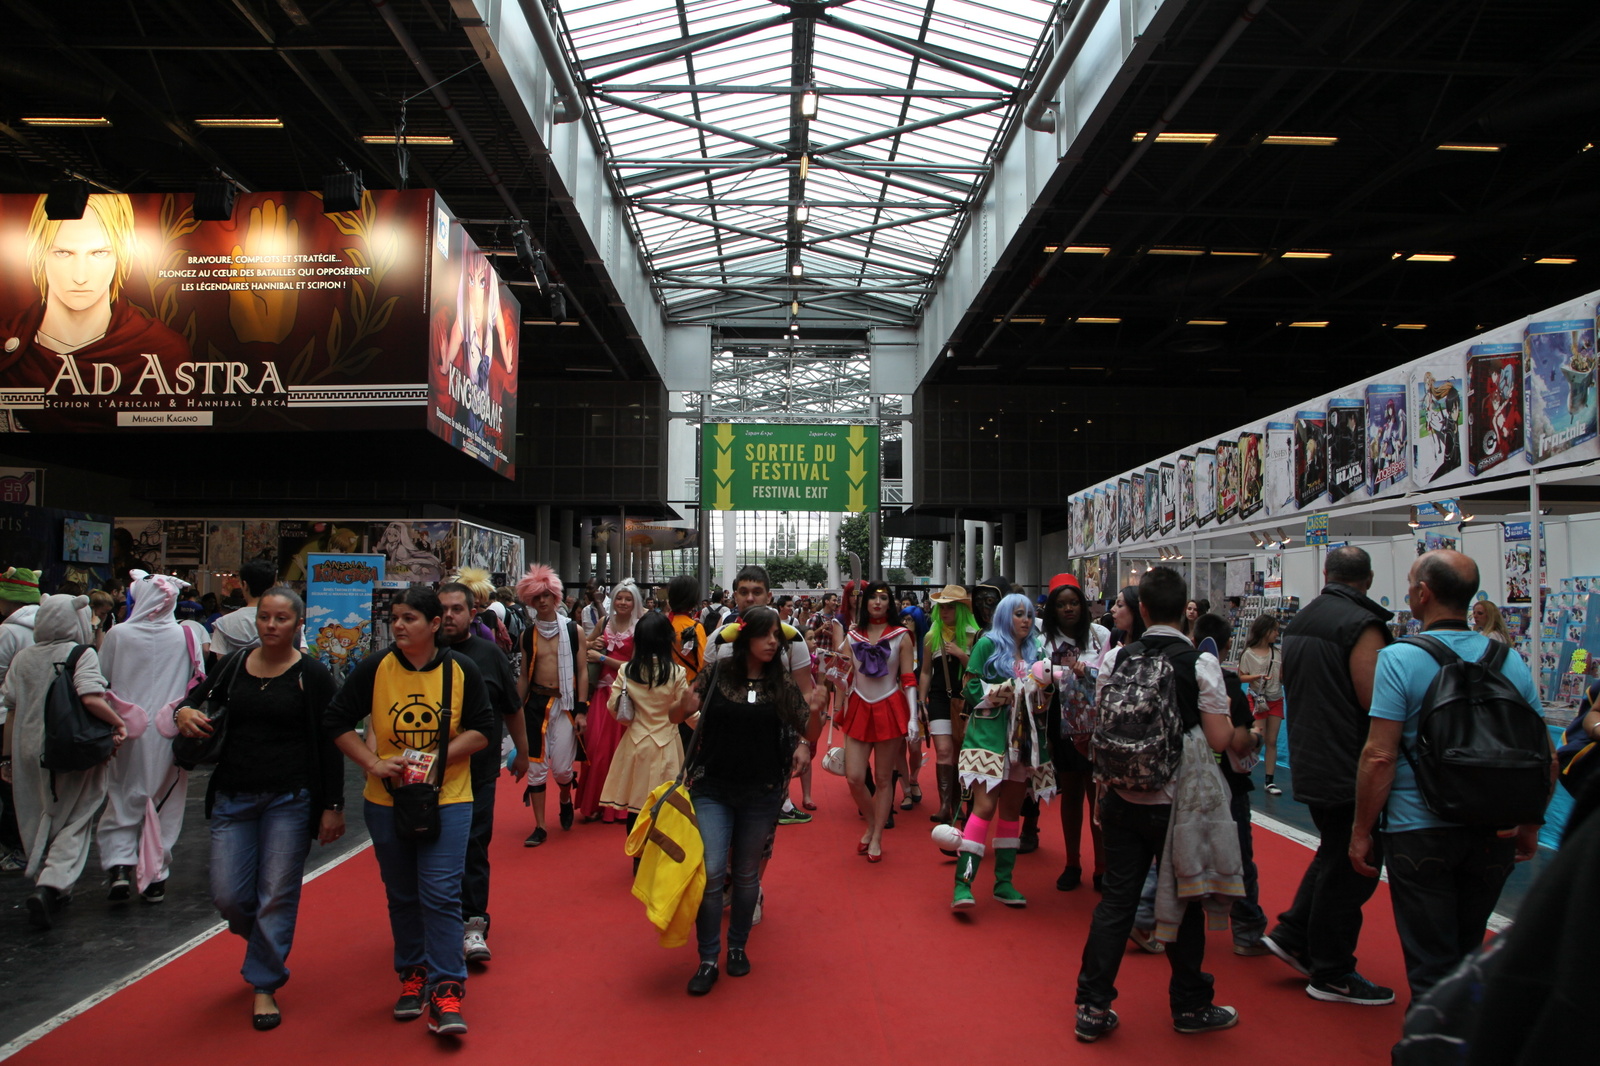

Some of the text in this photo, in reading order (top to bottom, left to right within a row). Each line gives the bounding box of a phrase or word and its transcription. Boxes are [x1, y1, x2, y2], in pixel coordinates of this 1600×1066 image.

[188, 253, 342, 265] BRAVOURE, COMPLOTS ET STRATÉGIE...
[158, 266, 371, 278] PLONGEZ AU CŒUR DES BATAILLES QUI OPPOSÈRENT
[181, 282, 194, 291] LES
[196, 281, 250, 291] LÉGENDAIRES
[251, 281, 294, 290] HANNIBAL
[296, 281, 306, 290] ET
[307, 281, 341, 290] SCIPION
[169, 399, 177, 408] &
[1538, 421, 1586, 458] fractale
[745, 443, 836, 462] SORTIE DU
[751, 462, 830, 481] FESTIVAL
[1335, 464, 1363, 486] BLACK
[752, 486, 828, 499] FESTIVAL EXIT
[1307, 516, 1328, 530] CAISSE
[1505, 526, 1511, 538] 3
[321, 560, 371, 570] ANIMAL
[312, 563, 379, 584] KINGDOM
